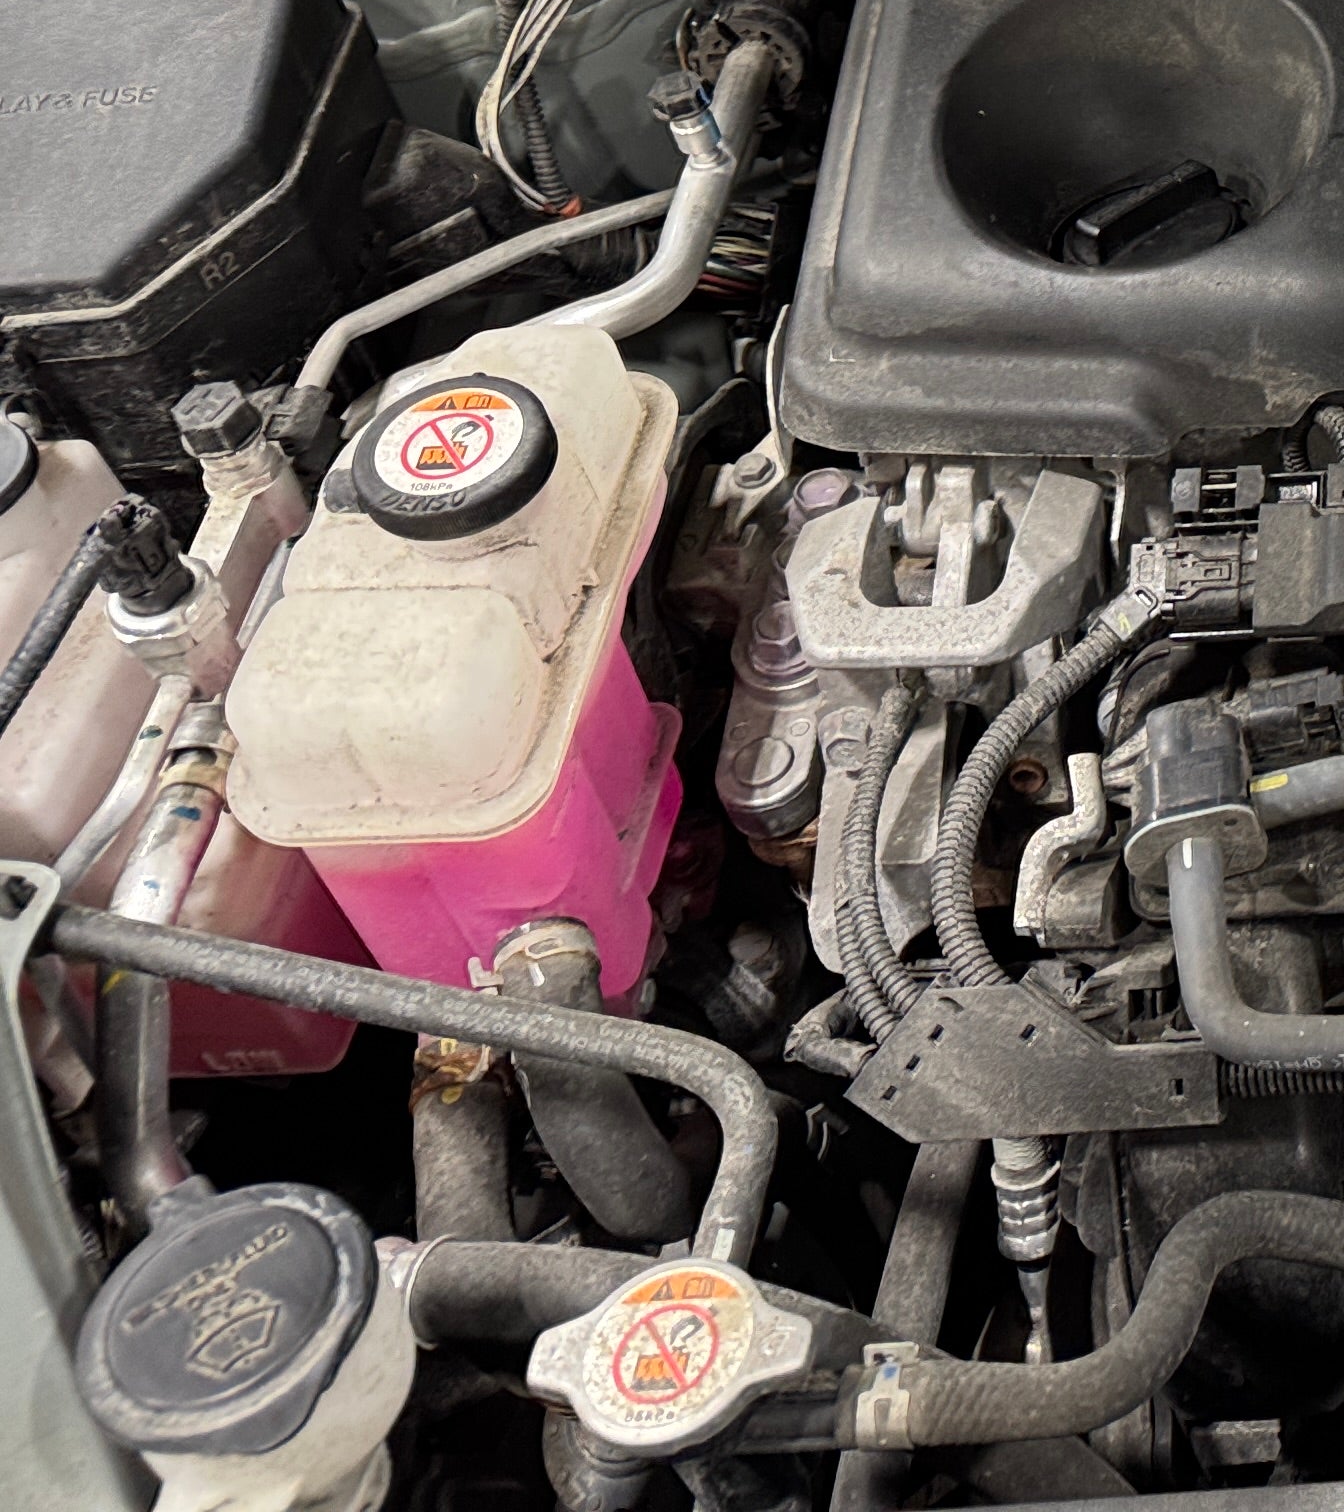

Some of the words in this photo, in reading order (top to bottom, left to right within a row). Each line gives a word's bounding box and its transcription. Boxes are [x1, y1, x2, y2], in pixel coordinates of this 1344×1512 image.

[82, 85, 158, 108] FUSE
[200, 252, 240, 291] R2
[410, 482, 453, 492] 108kPa
[380, 489, 466, 513] DENSO
